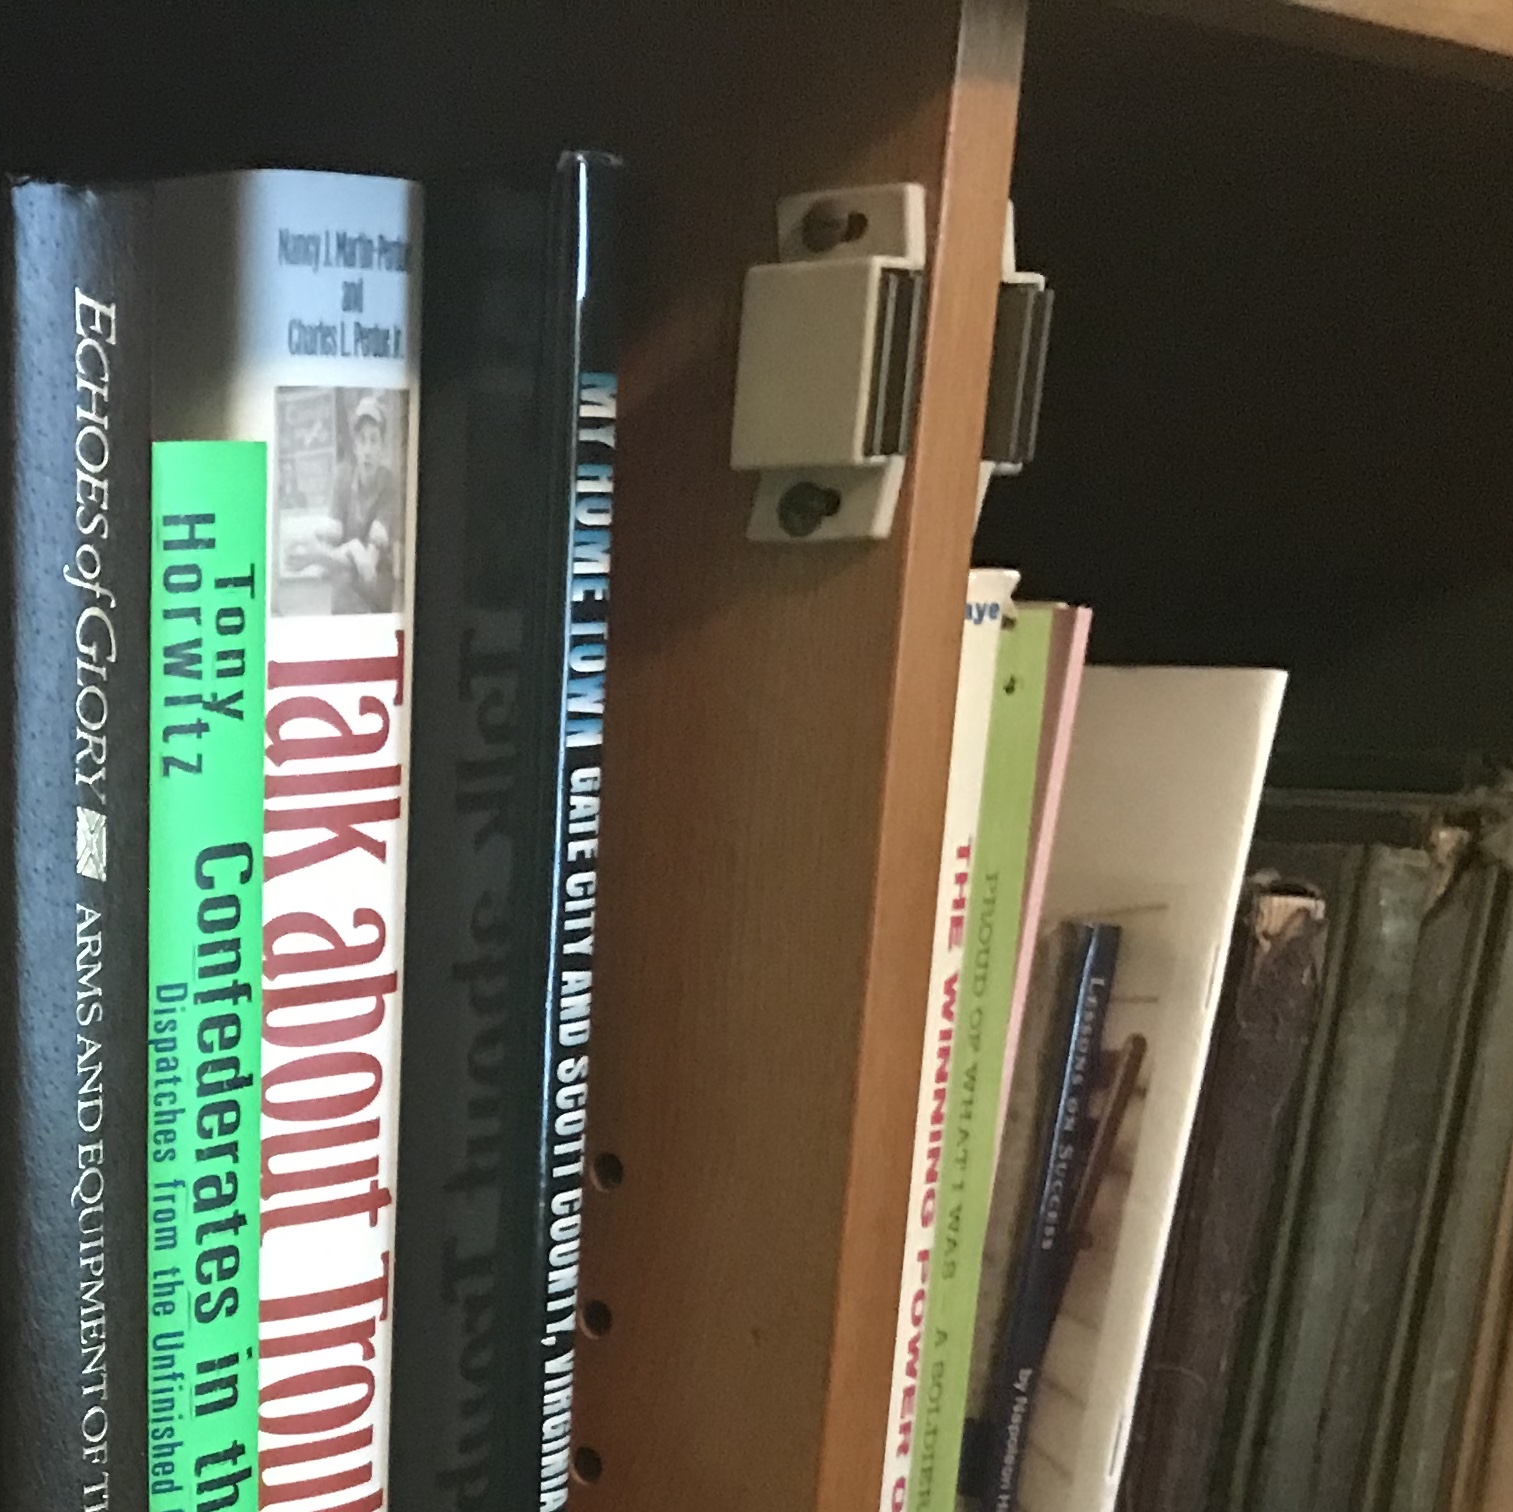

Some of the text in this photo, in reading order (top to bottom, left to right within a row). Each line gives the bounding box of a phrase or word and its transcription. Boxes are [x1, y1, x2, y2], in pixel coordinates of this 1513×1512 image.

[278, 228, 321, 273] Nancy
[341, 278, 363, 313] and
[288, 319, 337, 356] Charles
[578, 371, 618, 449] MY
[63, 286, 117, 804] ECHOES of GLORY
[162, 512, 216, 777] Horwitz
[207, 563, 255, 720] Tony
[263, 629, 405, 882] Talk
[567, 766, 601, 863] GATE
[562, 870, 597, 956] CITY
[948, 836, 973, 952] THE
[972, 872, 999, 998] PROUD
[75, 903, 103, 1026] ARMS
[558, 968, 593, 1048] AND
[76, 1032, 104, 1133] AND
[148, 982, 186, 1164] Dispatches
[193, 841, 254, 1324] Confederates
[259, 907, 399, 1248] about
[968, 1006, 984, 1053] OF
[551, 1054, 589, 1179] SCOTT
[921, 970, 959, 1228] WINNING
[954, 1061, 978, 1172] WHAT
[152, 1178, 186, 1252] from
[71, 1145, 107, 1400] EQUIPMENT
[152, 1262, 185, 1318] the
[193, 1347, 254, 1418] in
[895, 1248, 930, 1458] POWER
[1013, 1366, 1034, 1391] by
[82, 1405, 108, 1463] OF
[149, 1331, 186, 1495] Unfinished
[916, 1361, 945, 1512] SOLDIER
[1003, 1391, 1029, 1491] Napoleon
